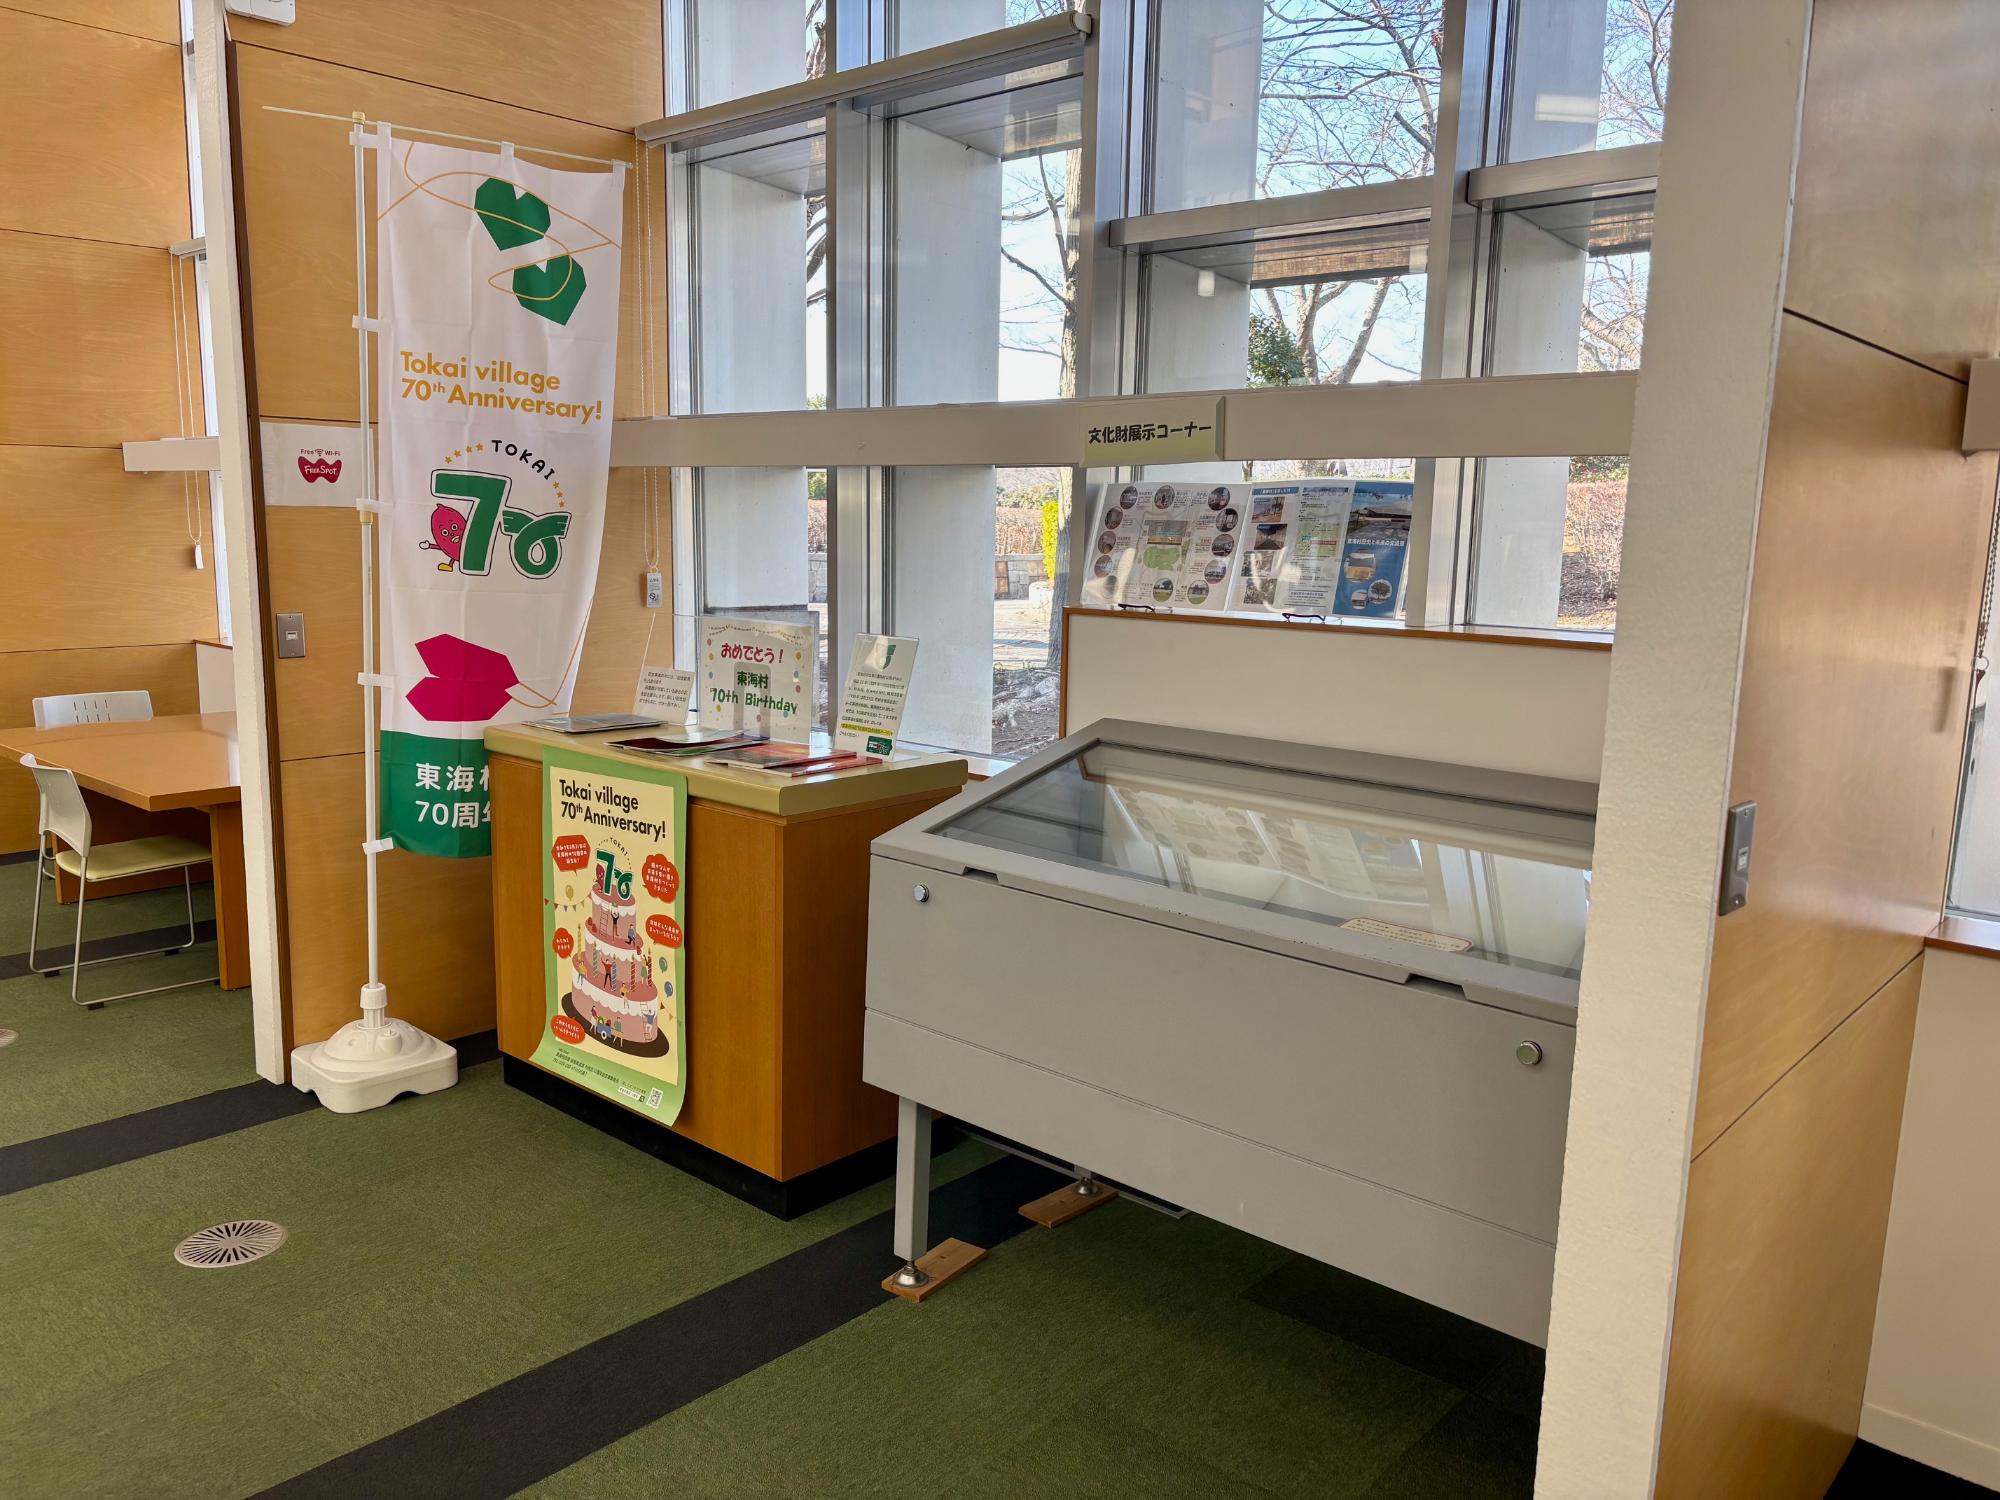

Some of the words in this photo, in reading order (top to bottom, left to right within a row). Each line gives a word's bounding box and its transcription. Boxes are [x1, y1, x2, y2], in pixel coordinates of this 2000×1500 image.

[401, 351, 467, 378] Tokai
[475, 360, 561, 394] village
[401, 378, 445, 401] 70th
[447, 384, 602, 424] Anniversary!
[1088, 421, 1212, 444] 文化財展示コーナー
[491, 439, 555, 480] TOKAI
[736, 671, 769, 690] 東海村
[745, 692, 798, 714] Birthday
[559, 779, 592, 801] Tokai
[595, 786, 639, 814] village
[561, 801, 583, 820] 70th
[584, 806, 666, 842] Anniversary!
[609, 837, 628, 856] TOKAI
